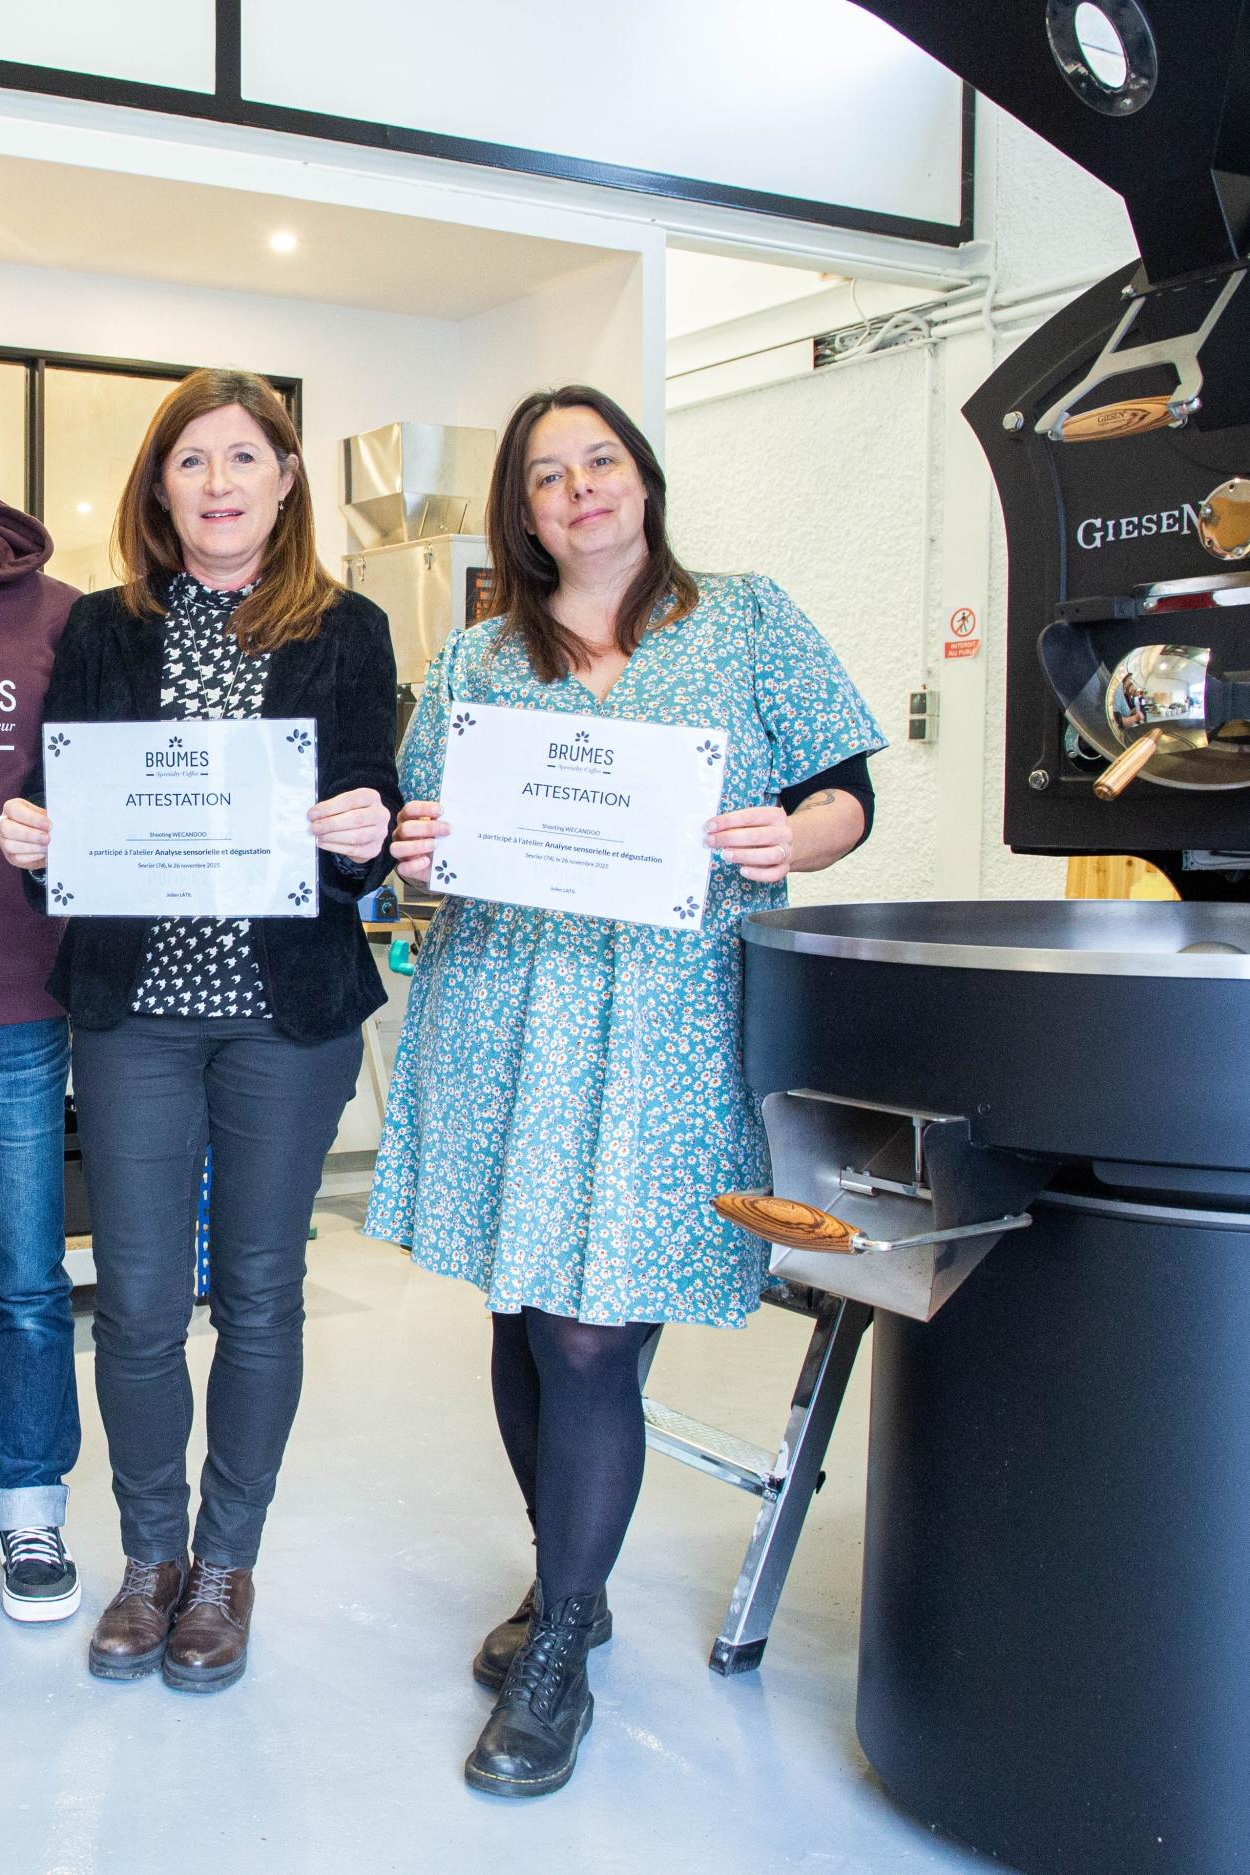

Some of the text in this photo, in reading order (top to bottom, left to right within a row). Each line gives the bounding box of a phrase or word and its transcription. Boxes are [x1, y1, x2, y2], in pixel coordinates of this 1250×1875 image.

[145, 750, 209, 768] BRUMES
[548, 742, 615, 766] BRUMES
[125, 792, 231, 807] ATTESTATION
[521, 782, 631, 808] ATTESTATION
[149, 831, 171, 839] Shooting
[93, 848, 123, 858] participé
[124, 848, 129, 856] à
[129, 848, 154, 856] l'atelier
[154, 848, 183, 858] Analyse
[183, 848, 220, 856] sensorielle
[221, 848, 229, 856] et
[229, 847, 271, 858] dégustation
[482, 832, 512, 844] participé
[512, 836, 518, 844] à
[518, 837, 544, 848] l'atelier
[545, 841, 573, 852] Analyse
[573, 845, 611, 857] sensorielle
[612, 850, 619, 858] et
[620, 851, 663, 864] dégustation
[568, 858, 595, 868] novembre
